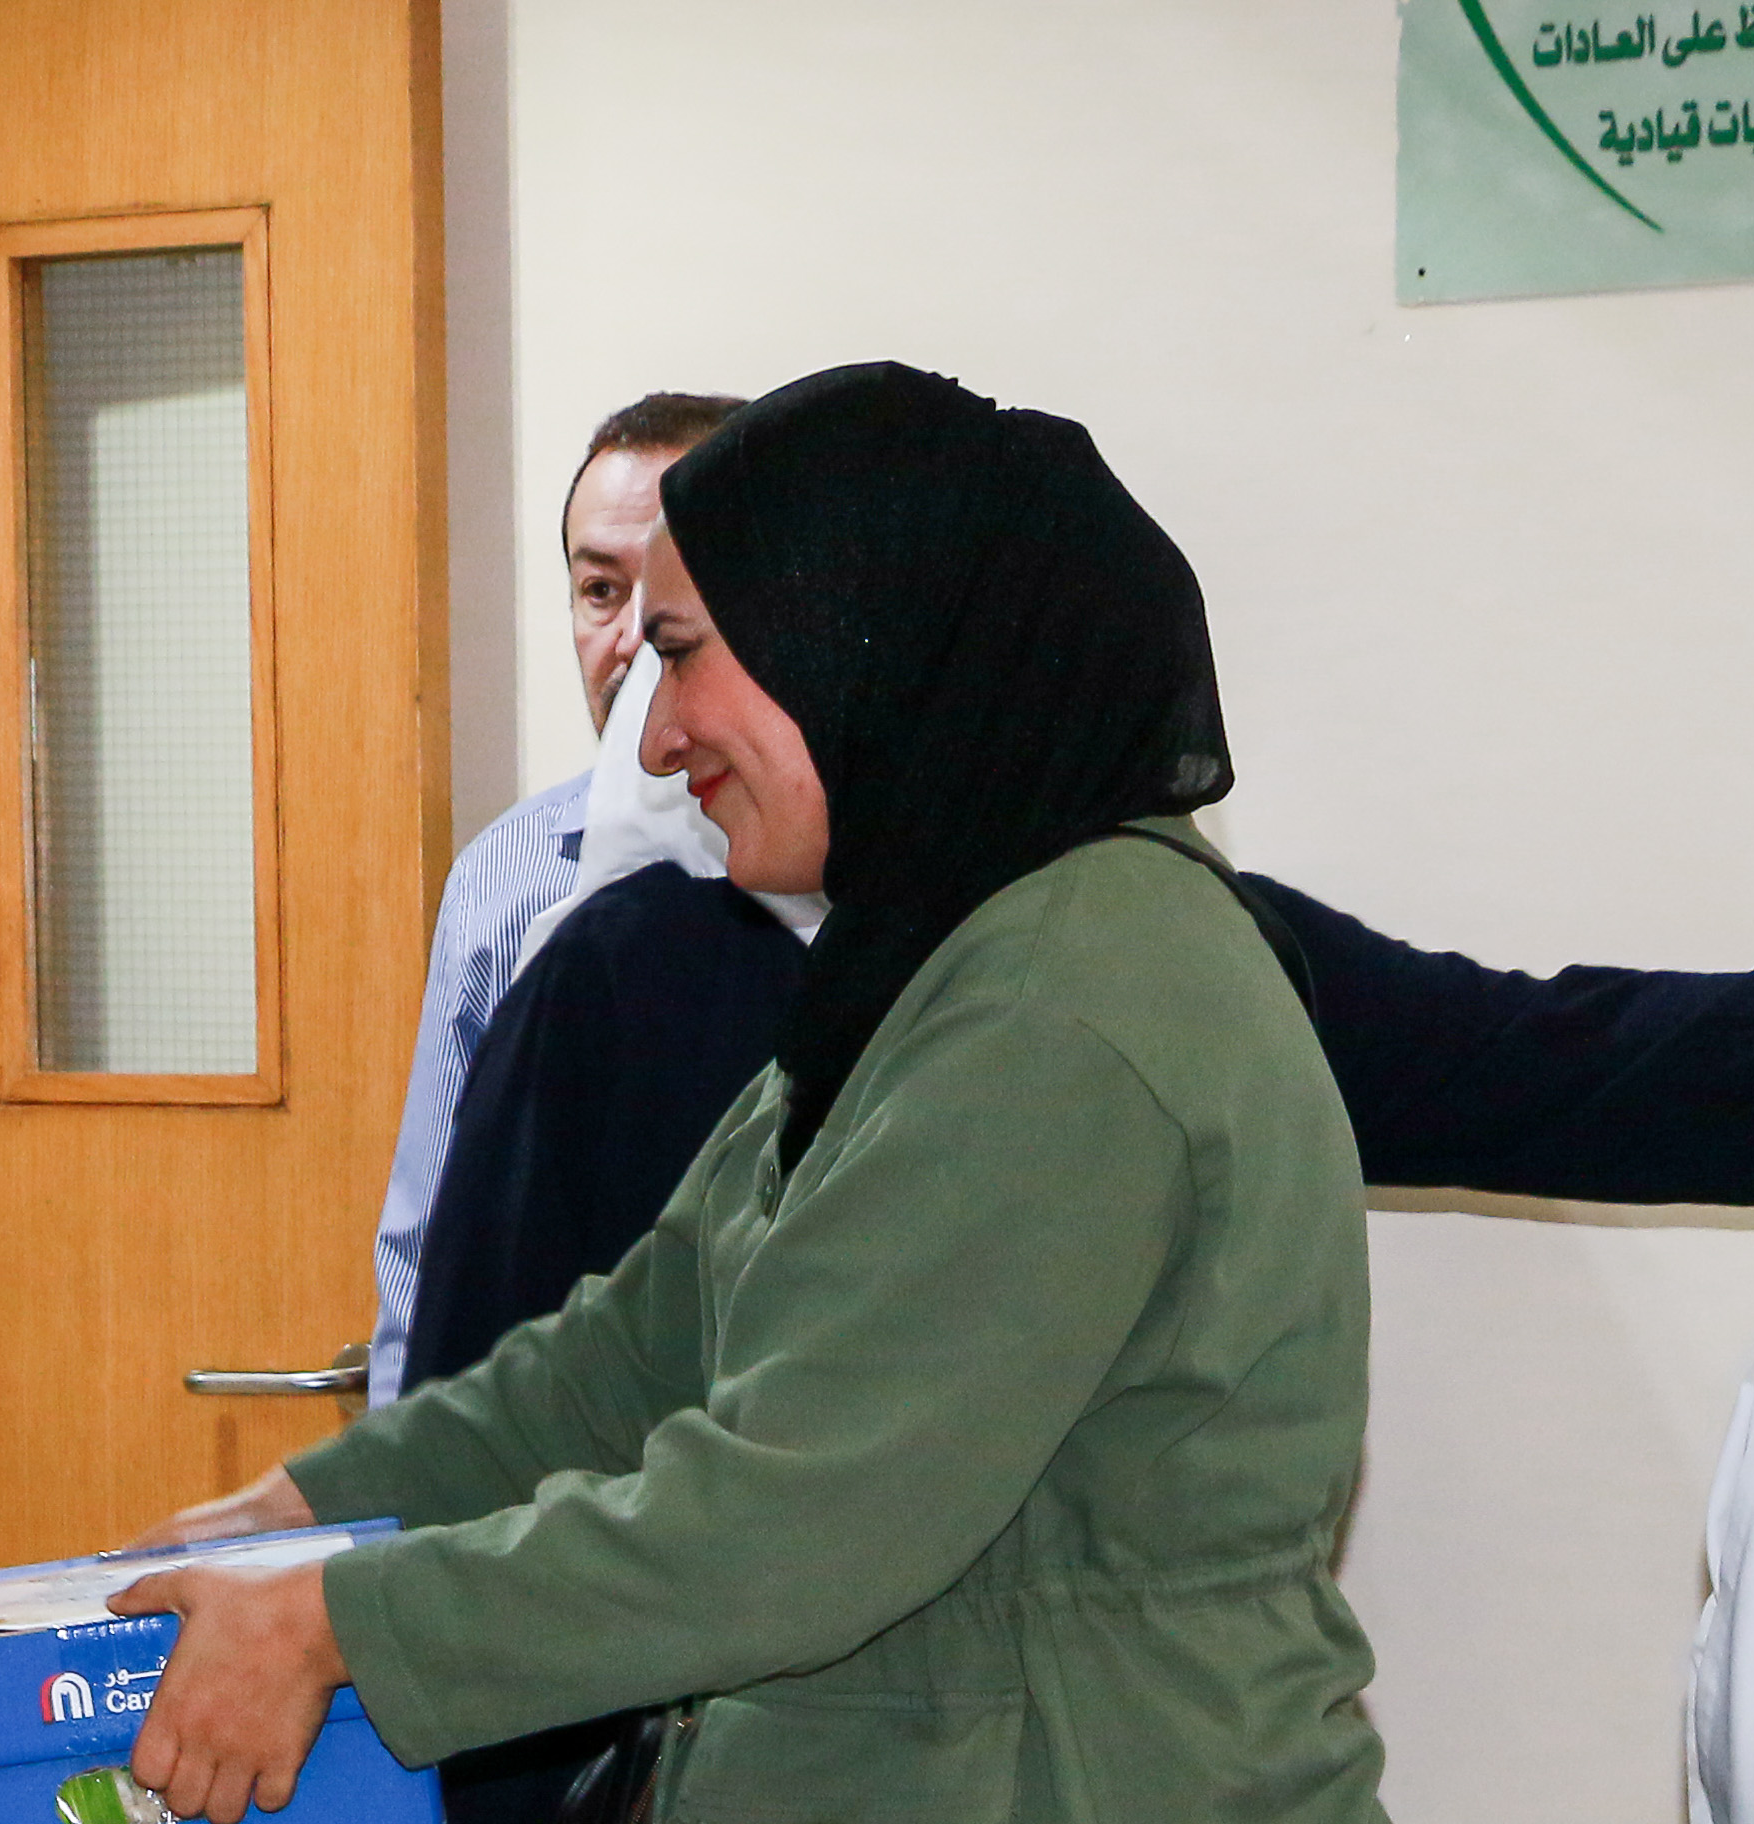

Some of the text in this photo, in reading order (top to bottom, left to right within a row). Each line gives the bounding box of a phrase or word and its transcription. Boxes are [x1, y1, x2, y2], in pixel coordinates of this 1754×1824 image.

[1531, 13, 1656, 68] العادات
[1661, 9, 1727, 68] على
[1598, 100, 1701, 167] قيادية
